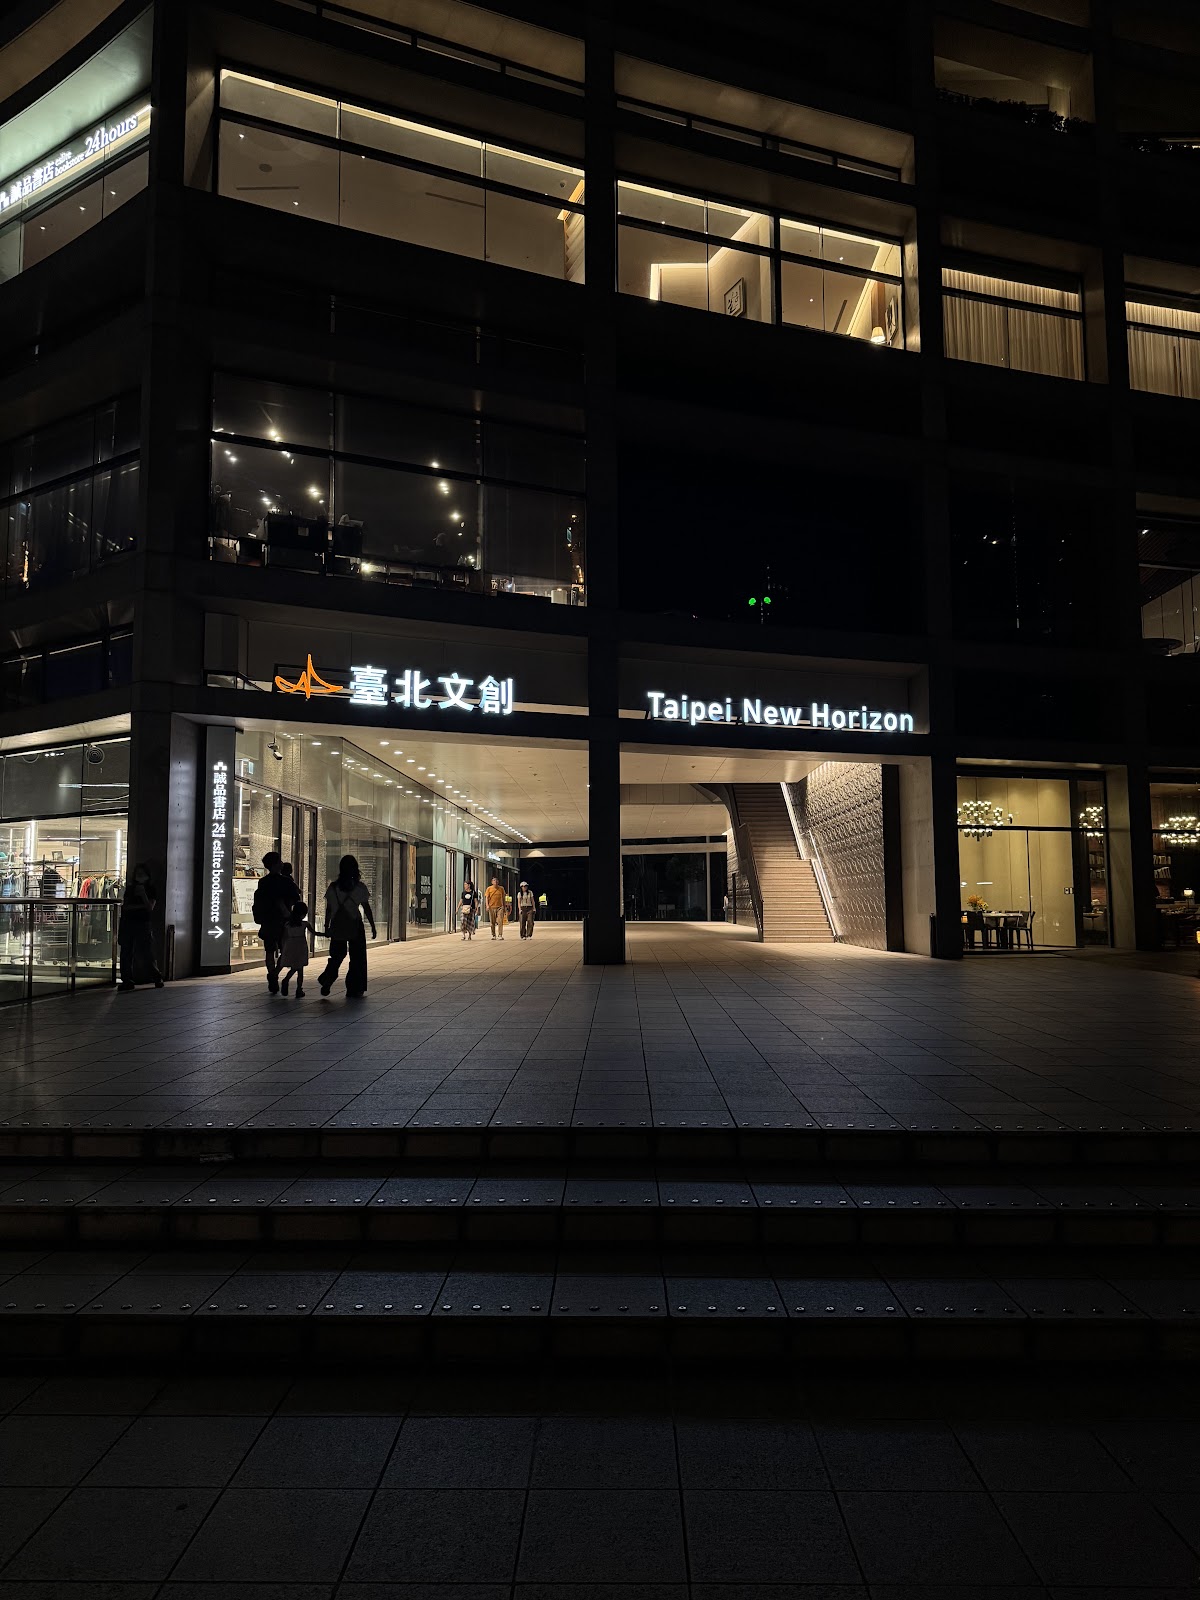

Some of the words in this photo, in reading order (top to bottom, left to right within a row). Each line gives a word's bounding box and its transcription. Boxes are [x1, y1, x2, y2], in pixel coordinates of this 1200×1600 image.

[349, 665, 514, 715] 臺北文創
[647, 691, 732, 726] Taipei
[743, 698, 802, 726] New
[811, 702, 914, 732] Horizon
[212, 772, 227, 820] 誠品書店
[211, 822, 226, 833] 24
[212, 839, 225, 868] eslite
[210, 867, 225, 923] bookstore
